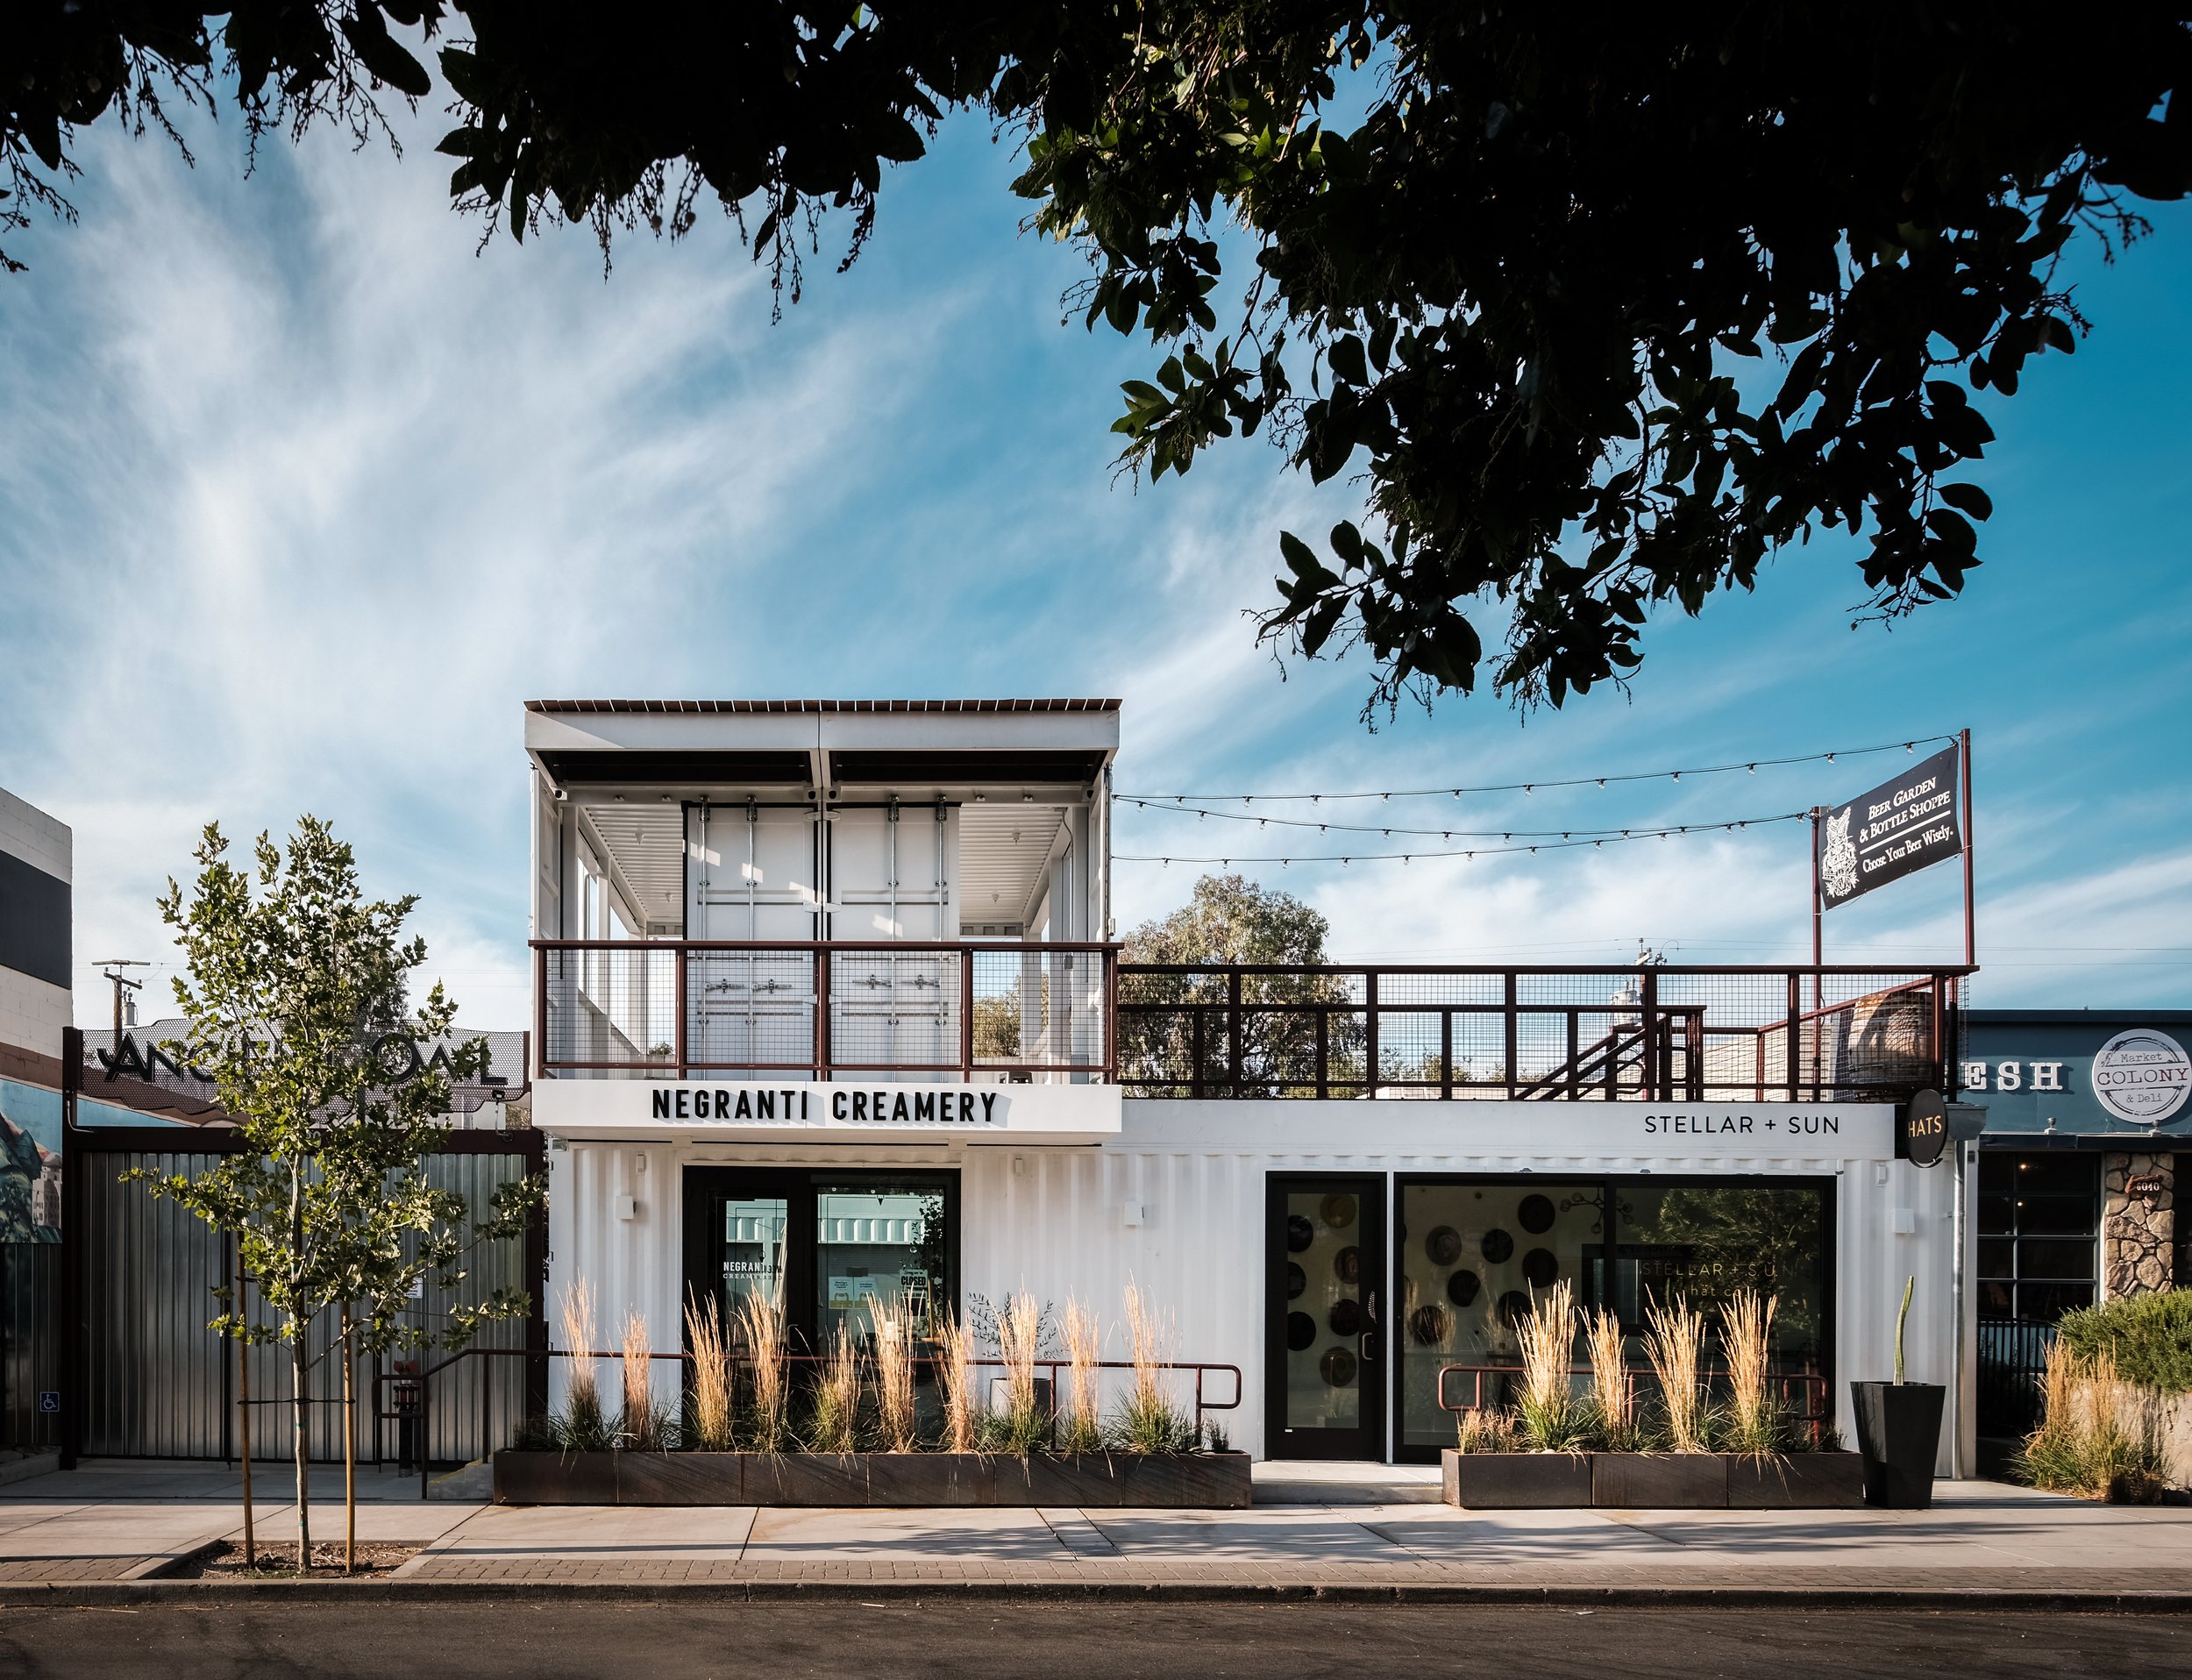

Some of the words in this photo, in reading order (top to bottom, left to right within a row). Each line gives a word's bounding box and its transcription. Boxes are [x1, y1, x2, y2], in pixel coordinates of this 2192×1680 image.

[1868, 800, 1891, 822] BEER
[1893, 777, 1937, 807] GARDEN
[1859, 829, 1868, 844] &
[1869, 812, 1909, 838] BOTTLE
[1909, 791, 1951, 820] SHOPPE
[1862, 856, 1886, 873] Choose
[1885, 847, 1906, 863] Your
[1904, 837, 1922, 855] Beer
[1921, 824, 1954, 846] Wisely.
[2121, 1052, 2162, 1063] Market
[1944, 1062, 2063, 1091] ESH
[2097, 1068, 2189, 1086] COLONY
[652, 1089, 808, 1120] NEGRANTI
[832, 1091, 997, 1122] CREAMERY
[2138, 1093, 2162, 1103] Deli
[1644, 1115, 1754, 1134] STELLAR
[1765, 1120, 1776, 1131] +
[1788, 1116, 1840, 1135] SUN
[1908, 1114, 1942, 1138] HATS
[2136, 1182, 2160, 1192] 6040
[900, 1276, 927, 1286] CLOSED
